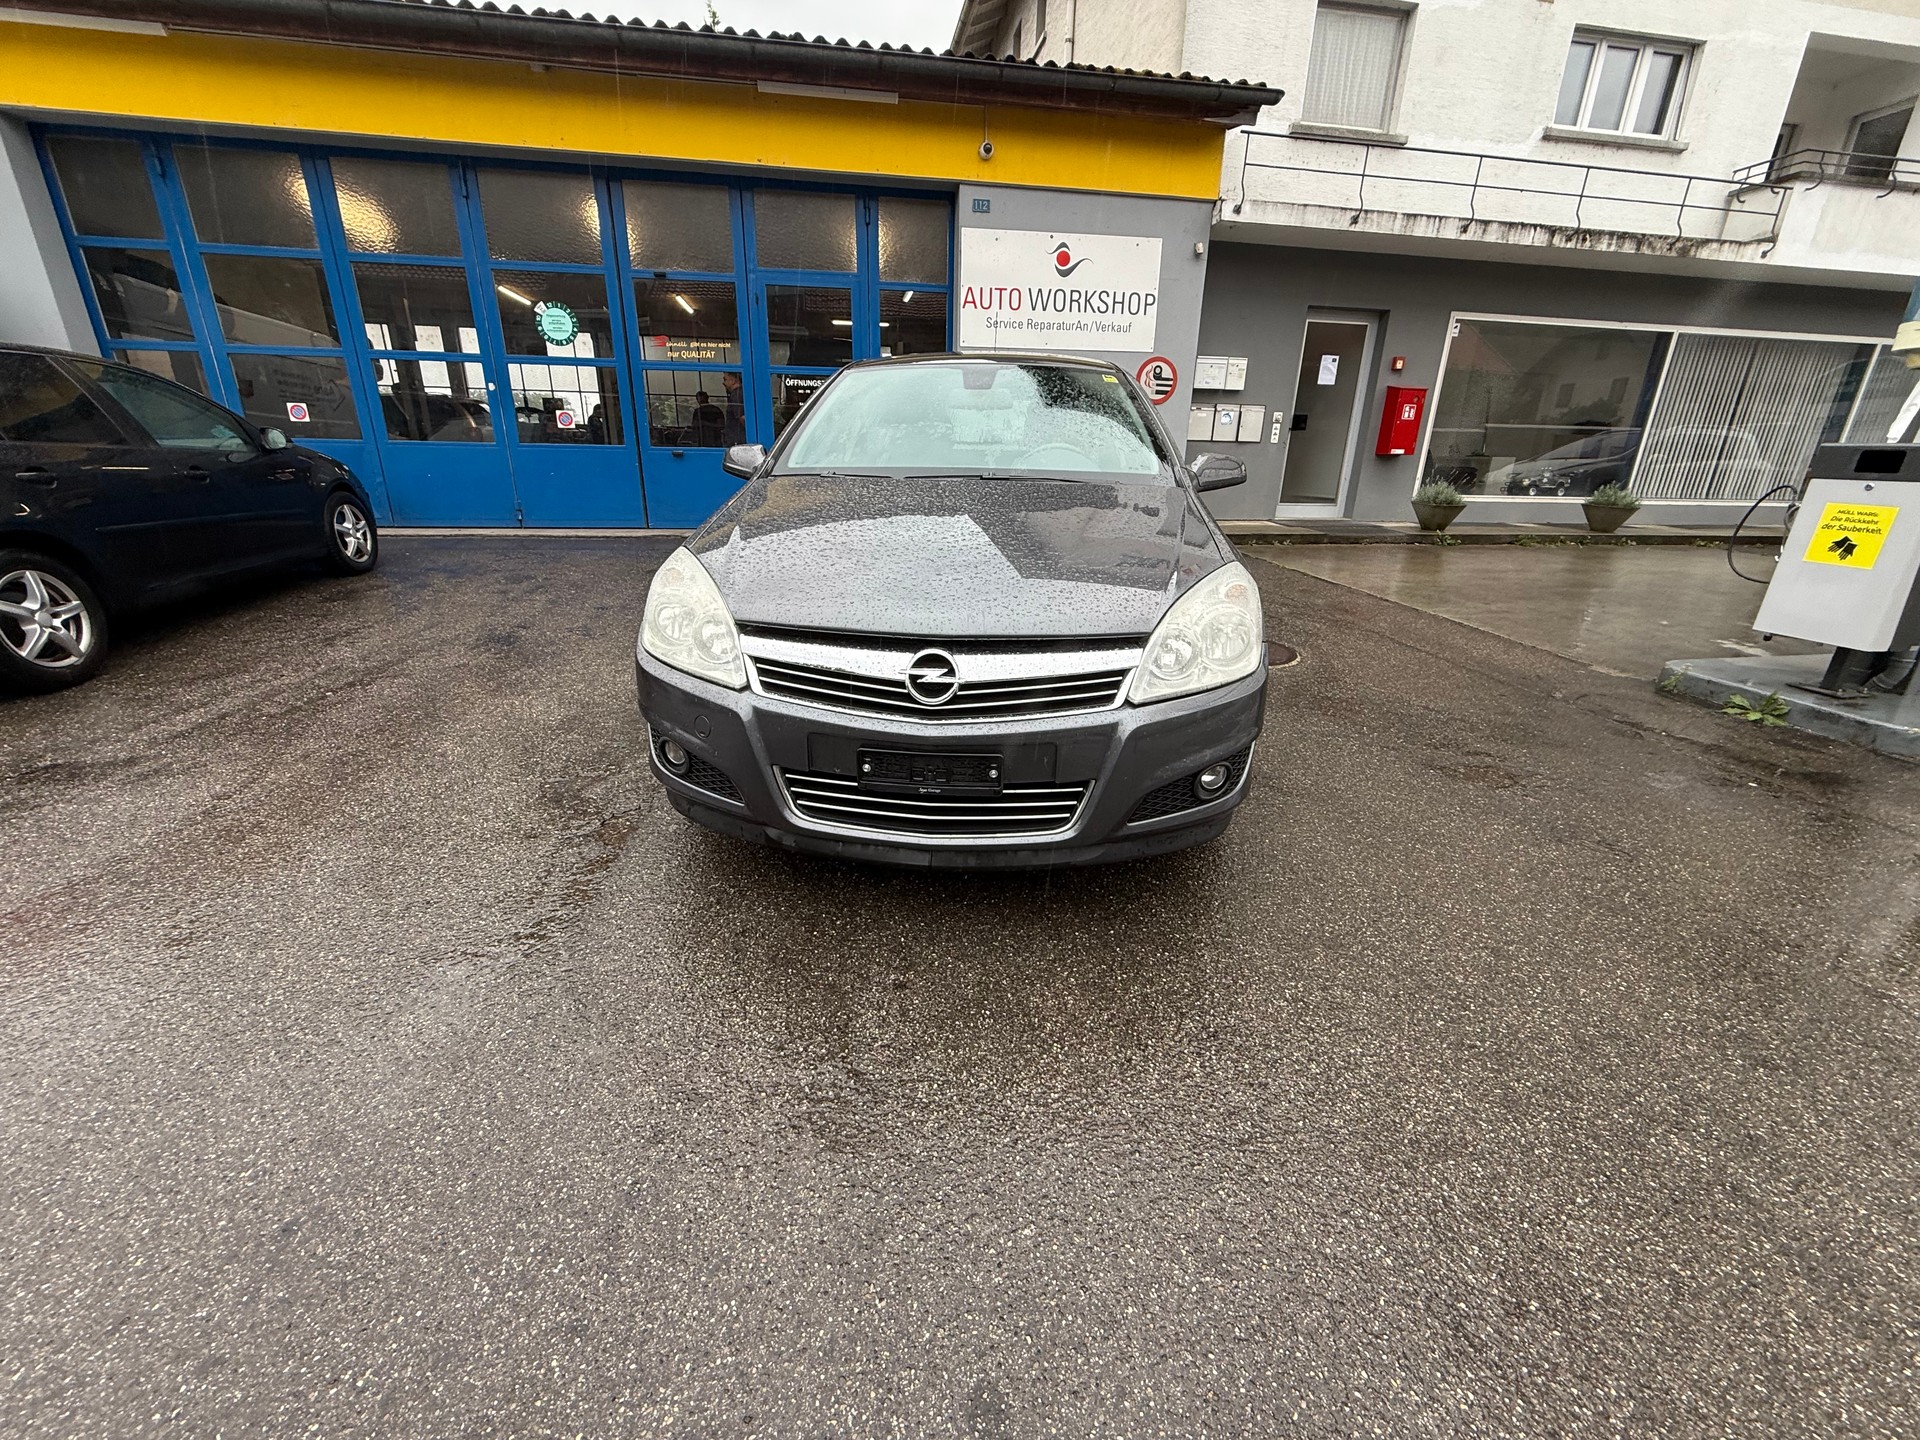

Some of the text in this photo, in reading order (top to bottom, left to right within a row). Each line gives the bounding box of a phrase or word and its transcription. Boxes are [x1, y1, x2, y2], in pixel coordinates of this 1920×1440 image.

[974, 200, 988, 210] 112
[962, 286, 1156, 316] AUTO WORKSHOP
[985, 316, 1023, 330] Service
[681, 350, 716, 359] QUALITÄT
[1837, 508, 1855, 516] MÜLL
[1844, 516, 1880, 525] Rückkehr
[1821, 522, 1883, 535] der Sauberkeit
